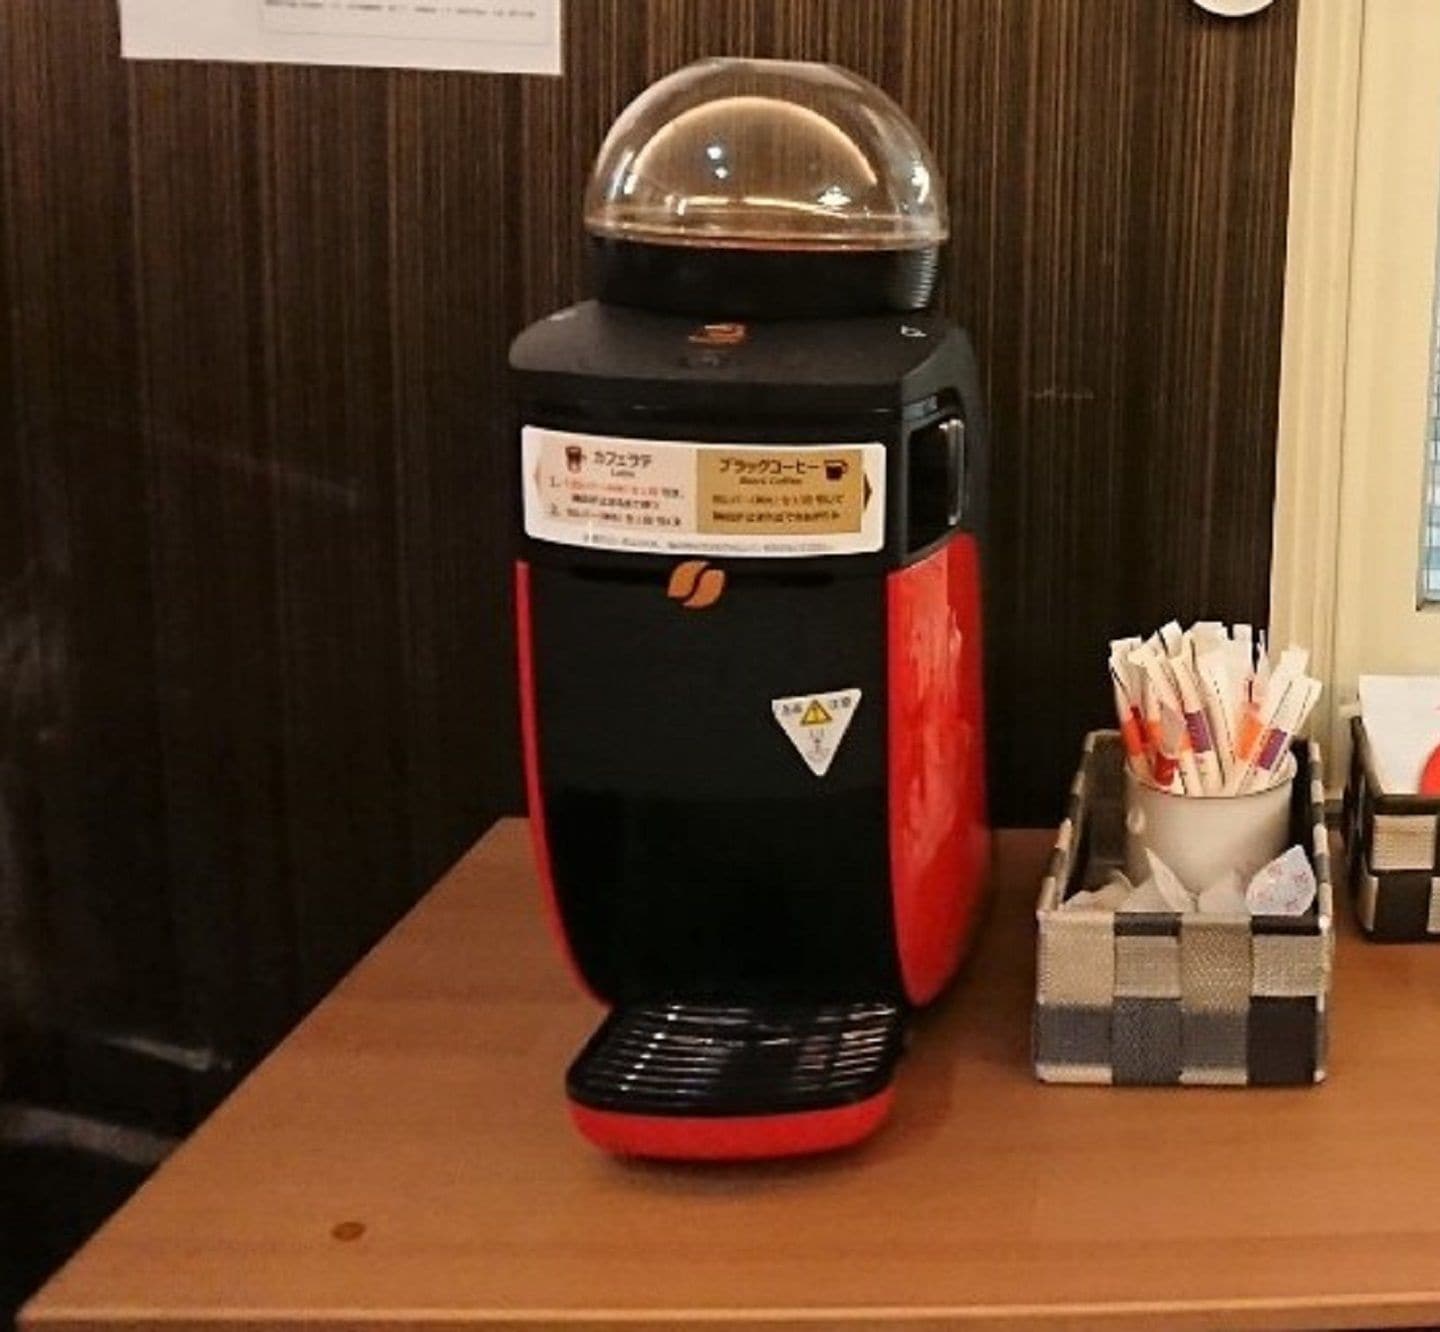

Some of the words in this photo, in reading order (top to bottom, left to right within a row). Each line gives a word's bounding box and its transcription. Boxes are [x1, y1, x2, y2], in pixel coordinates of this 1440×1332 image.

[594, 451, 653, 467] カフェラテ
[719, 457, 820, 474] ブラックコーヒー
